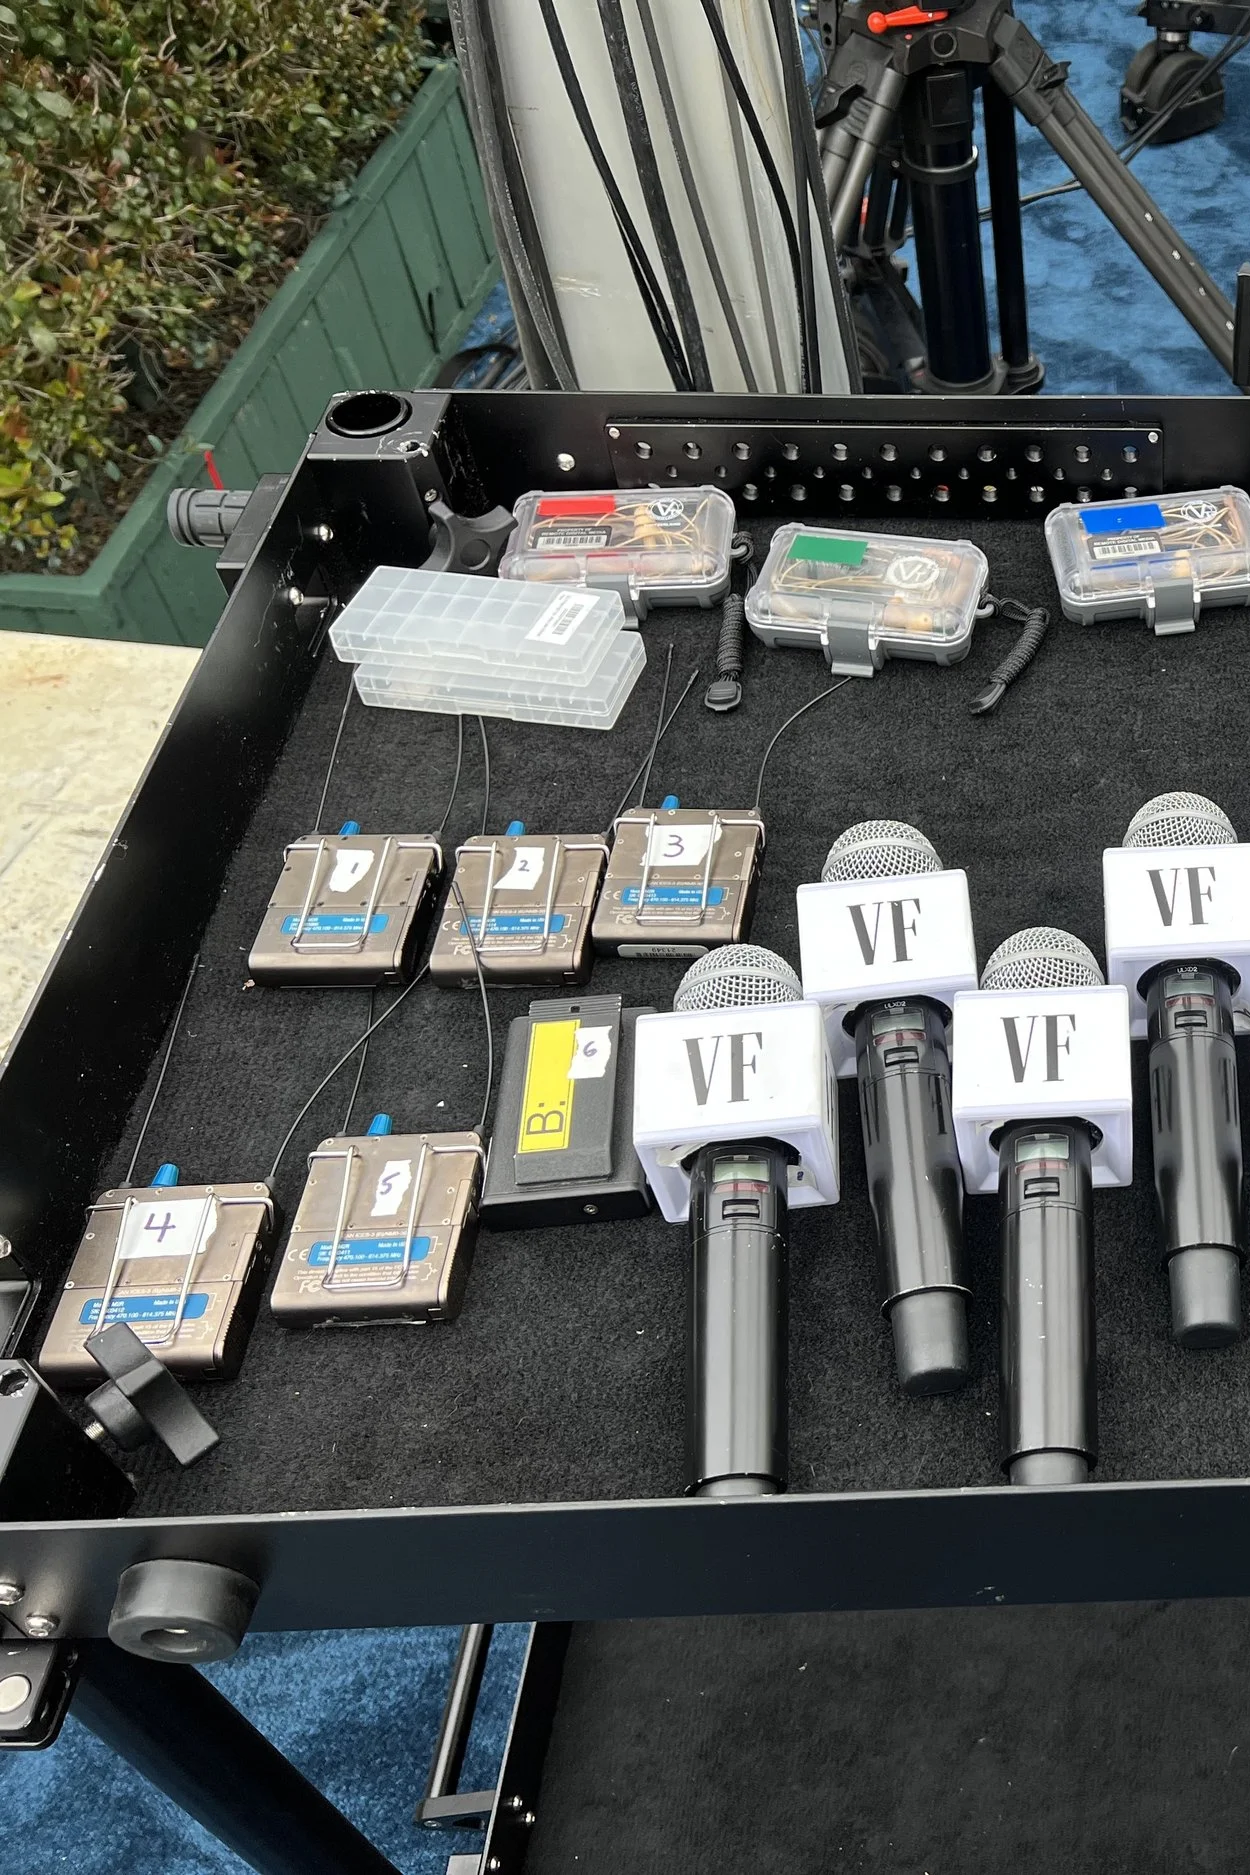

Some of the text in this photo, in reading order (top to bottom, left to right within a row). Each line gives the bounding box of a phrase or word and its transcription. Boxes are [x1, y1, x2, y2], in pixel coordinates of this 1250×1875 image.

[663, 834, 685, 858] 3
[517, 859, 530, 872] 2
[1146, 866, 1216, 926] VF
[846, 898, 921, 965] VF
[884, 1001, 906, 1009] ULXD2
[583, 1040, 598, 1058] 6
[1000, 1014, 1076, 1083] VF
[682, 1032, 763, 1106] VF
[143, 1211, 176, 1243] 4
[288, 1249, 309, 1261] CE
